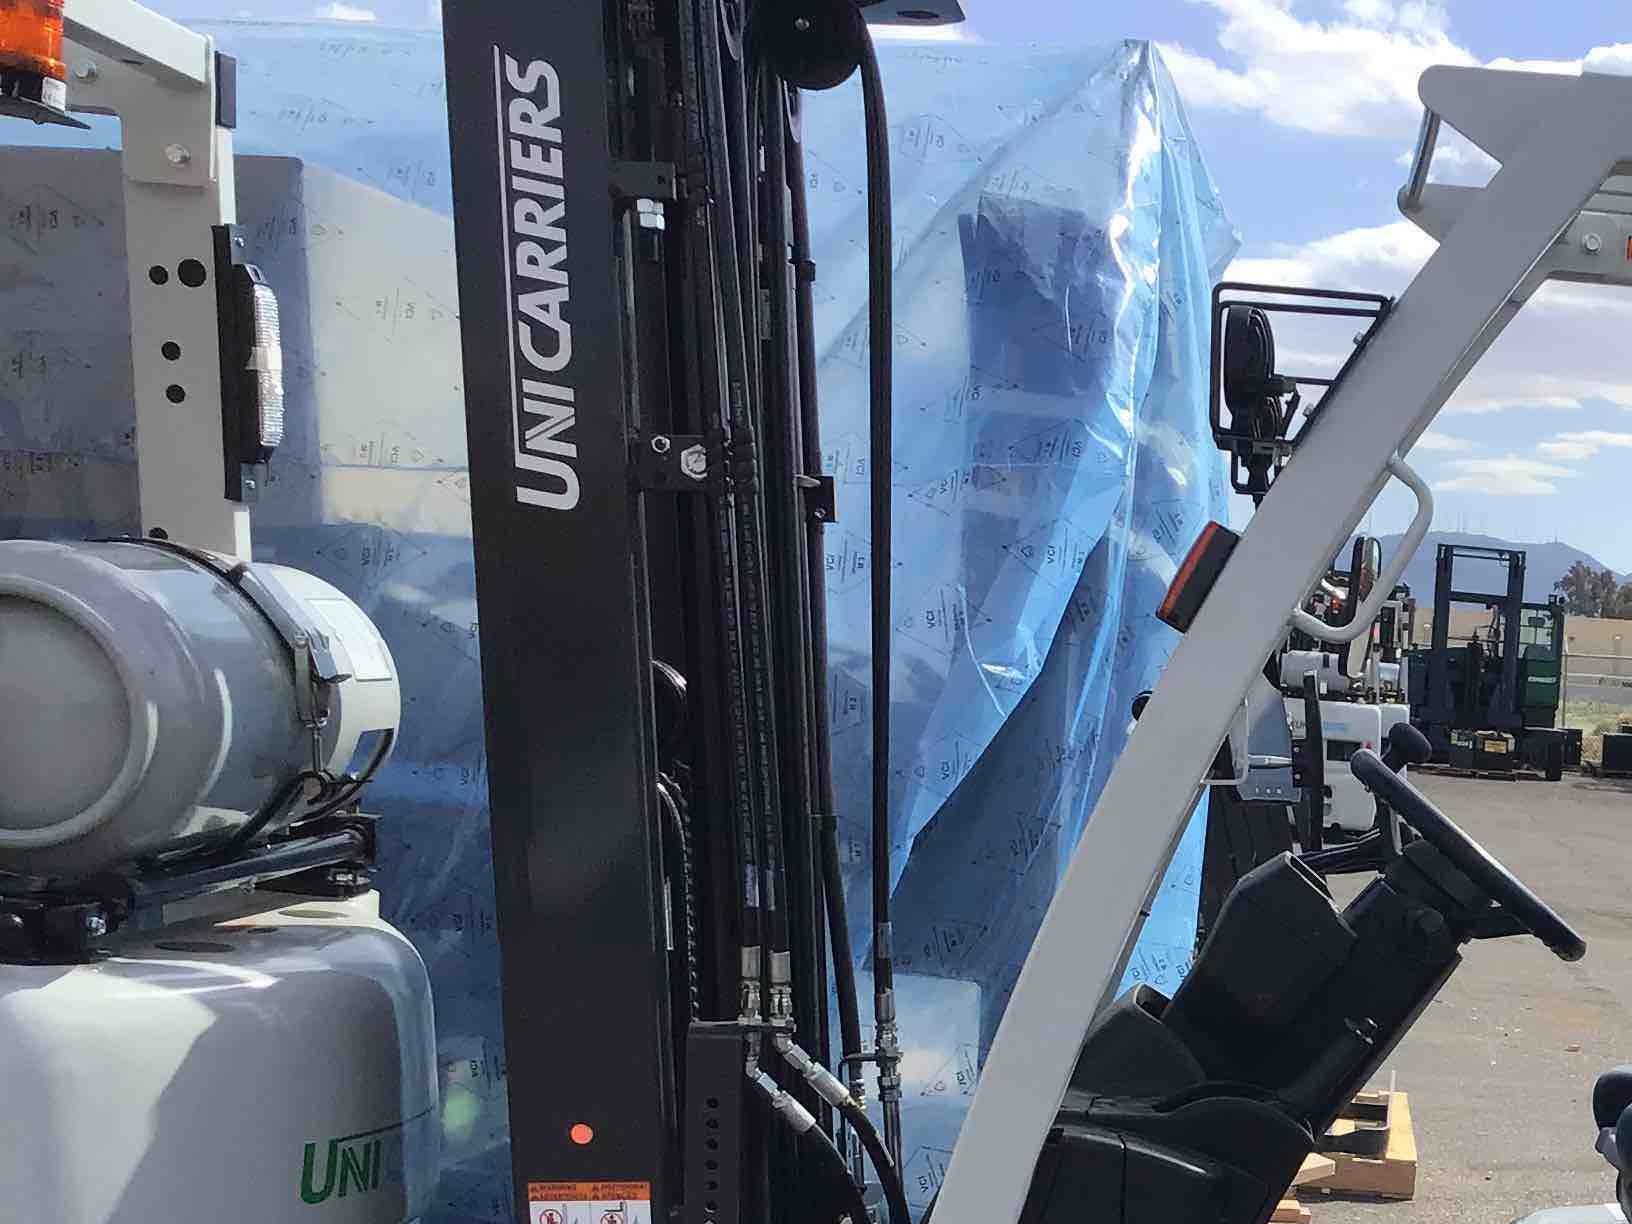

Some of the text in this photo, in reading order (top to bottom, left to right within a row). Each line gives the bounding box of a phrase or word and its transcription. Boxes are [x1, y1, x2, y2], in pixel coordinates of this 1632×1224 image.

[825, 553, 835, 571] VCI
[1047, 544, 1056, 564] VCI
[926, 610, 936, 630] VCI
